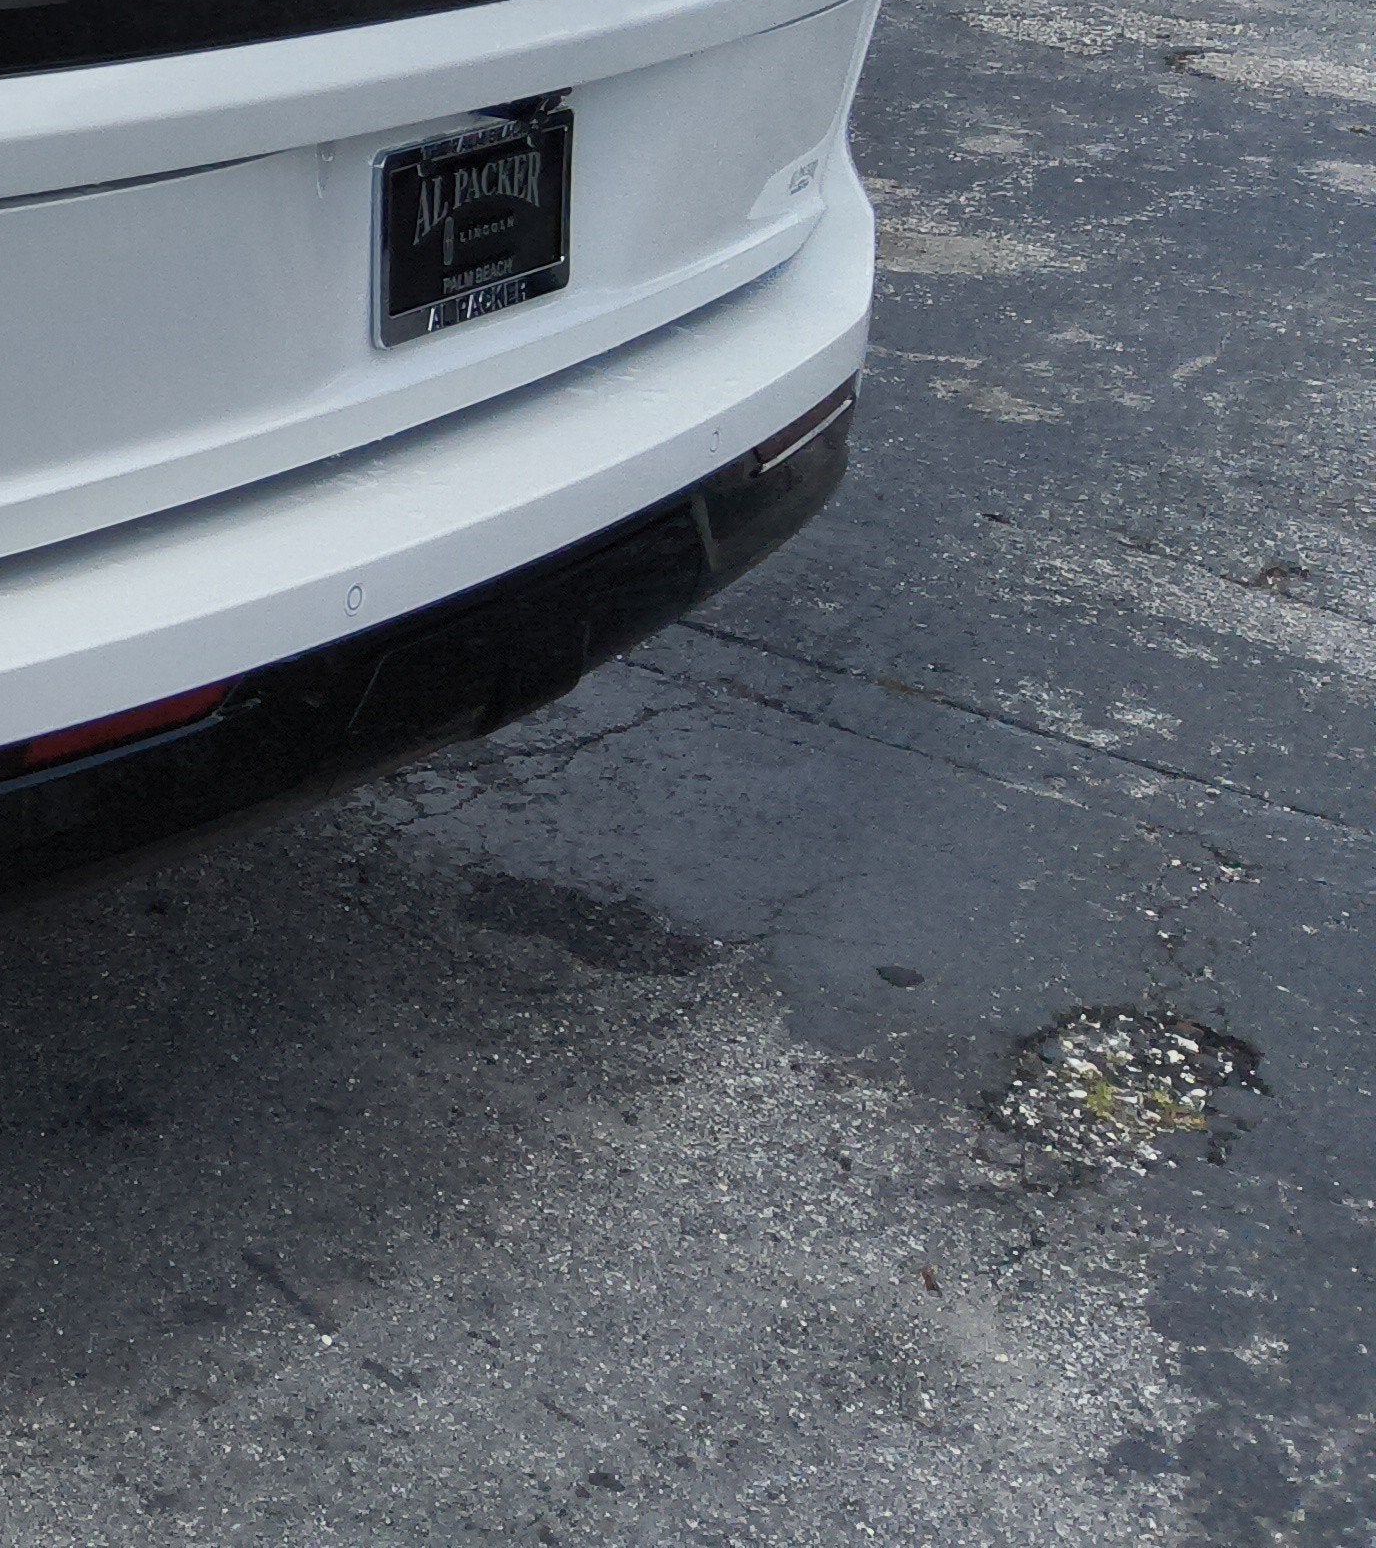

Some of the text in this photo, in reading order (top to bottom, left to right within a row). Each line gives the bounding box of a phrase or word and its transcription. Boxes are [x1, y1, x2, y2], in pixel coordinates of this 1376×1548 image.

[413, 151, 541, 245] AL PACKER
[459, 215, 515, 243] LINCOLN
